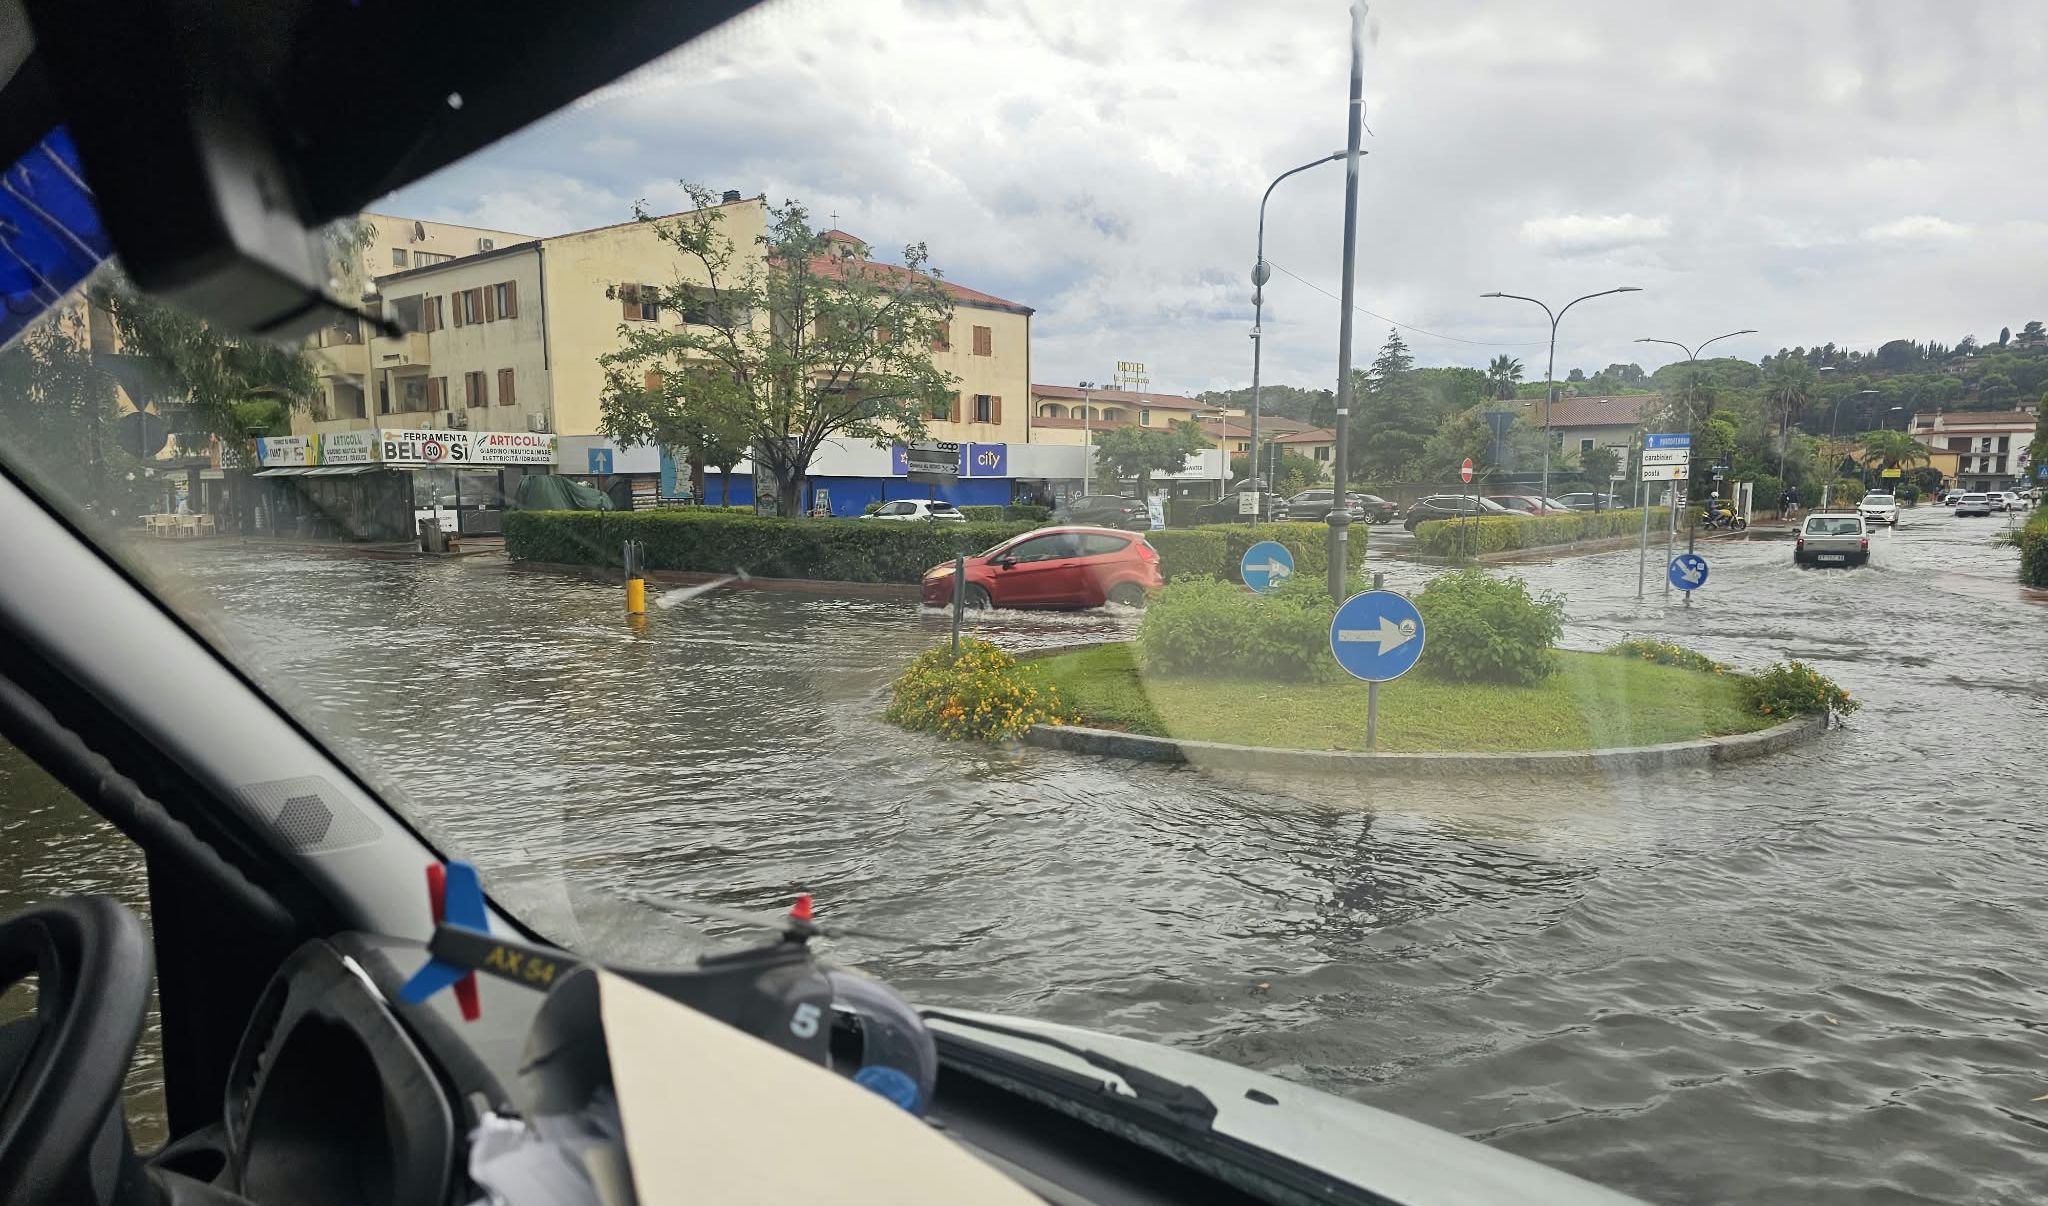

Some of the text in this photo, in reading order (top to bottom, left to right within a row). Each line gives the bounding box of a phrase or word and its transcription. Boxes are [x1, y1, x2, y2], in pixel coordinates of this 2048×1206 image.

[1117, 361, 1146, 373] HOTEL
[404, 432, 468, 442] FERRAMENTA
[490, 435, 540, 446] ARTICOLI
[427, 446, 438, 456] 30
[978, 451, 1000, 470] city
[1644, 453, 1673, 461] carabinieri
[1643, 470, 1660, 478] posta
[484, 946, 556, 984] AX 54
[789, 1003, 821, 1039] 5
